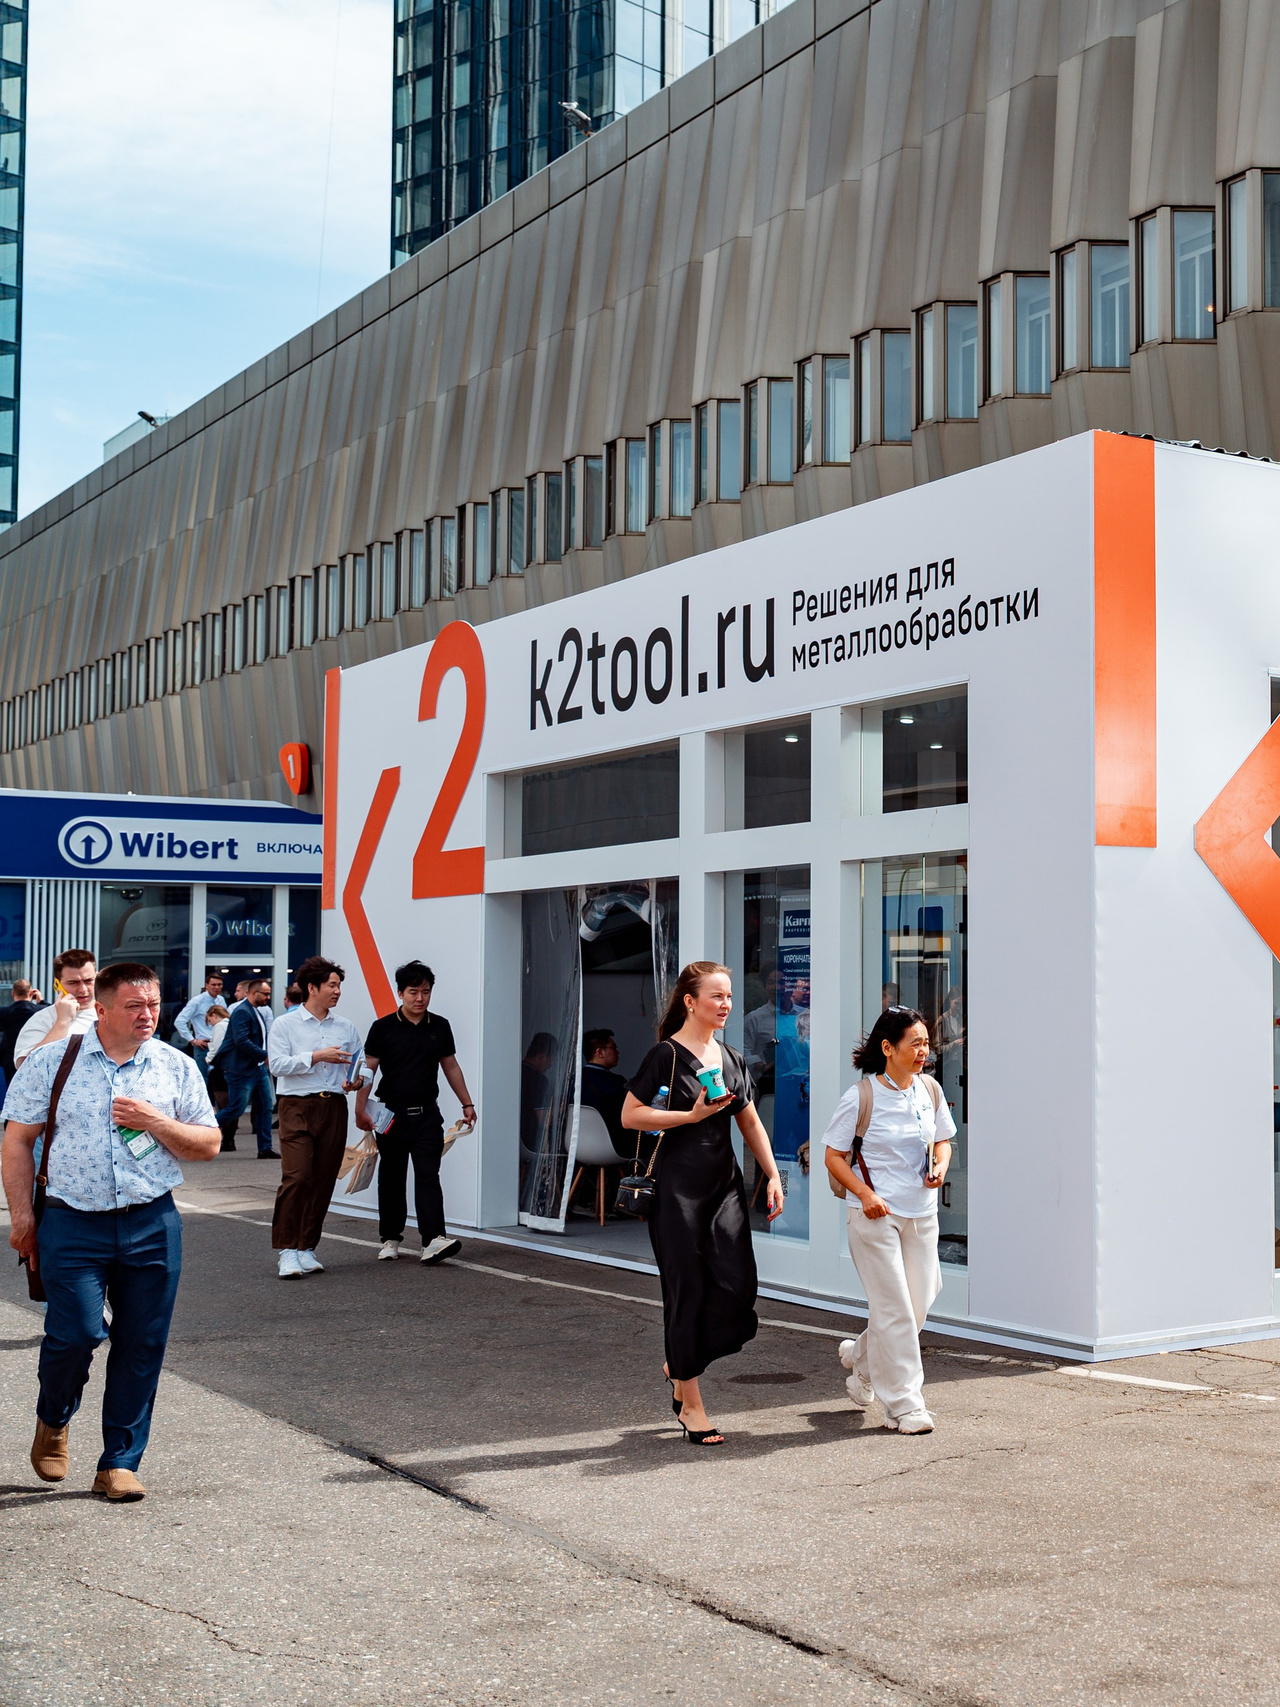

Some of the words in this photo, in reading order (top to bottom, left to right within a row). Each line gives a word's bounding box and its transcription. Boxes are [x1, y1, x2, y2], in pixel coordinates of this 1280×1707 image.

[793, 573, 898, 626] Решения
[906, 557, 955, 604] для
[793, 587, 1039, 662] металлообработки
[530, 595, 776, 730] k2tool.ru
[287, 754, 296, 780] 1
[119, 831, 239, 860] Wibert
[256, 841, 323, 855] ВКЛЮЧА
